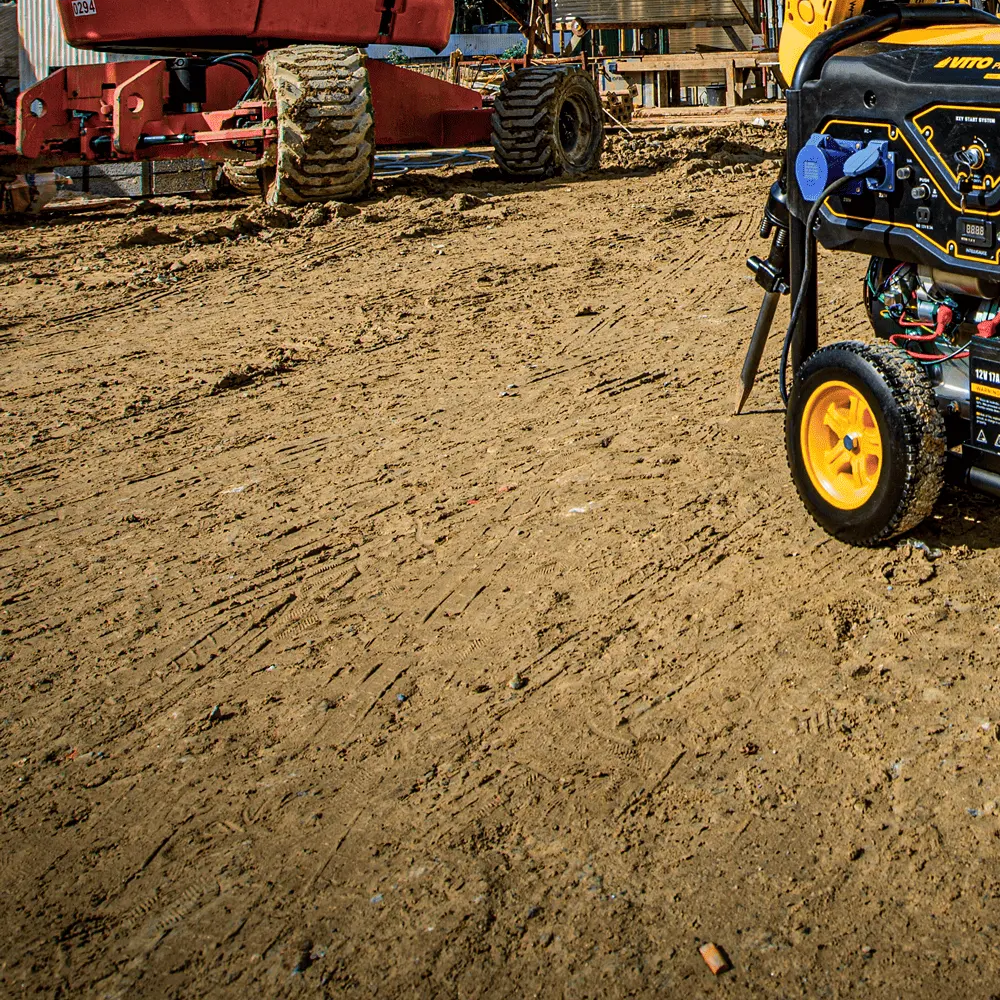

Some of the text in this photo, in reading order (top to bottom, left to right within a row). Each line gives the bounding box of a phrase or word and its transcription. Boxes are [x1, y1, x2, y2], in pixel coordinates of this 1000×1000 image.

[73, 1, 96, 16] 0294
[948, 56, 994, 69] VITO
[975, 368, 988, 381] 12V
